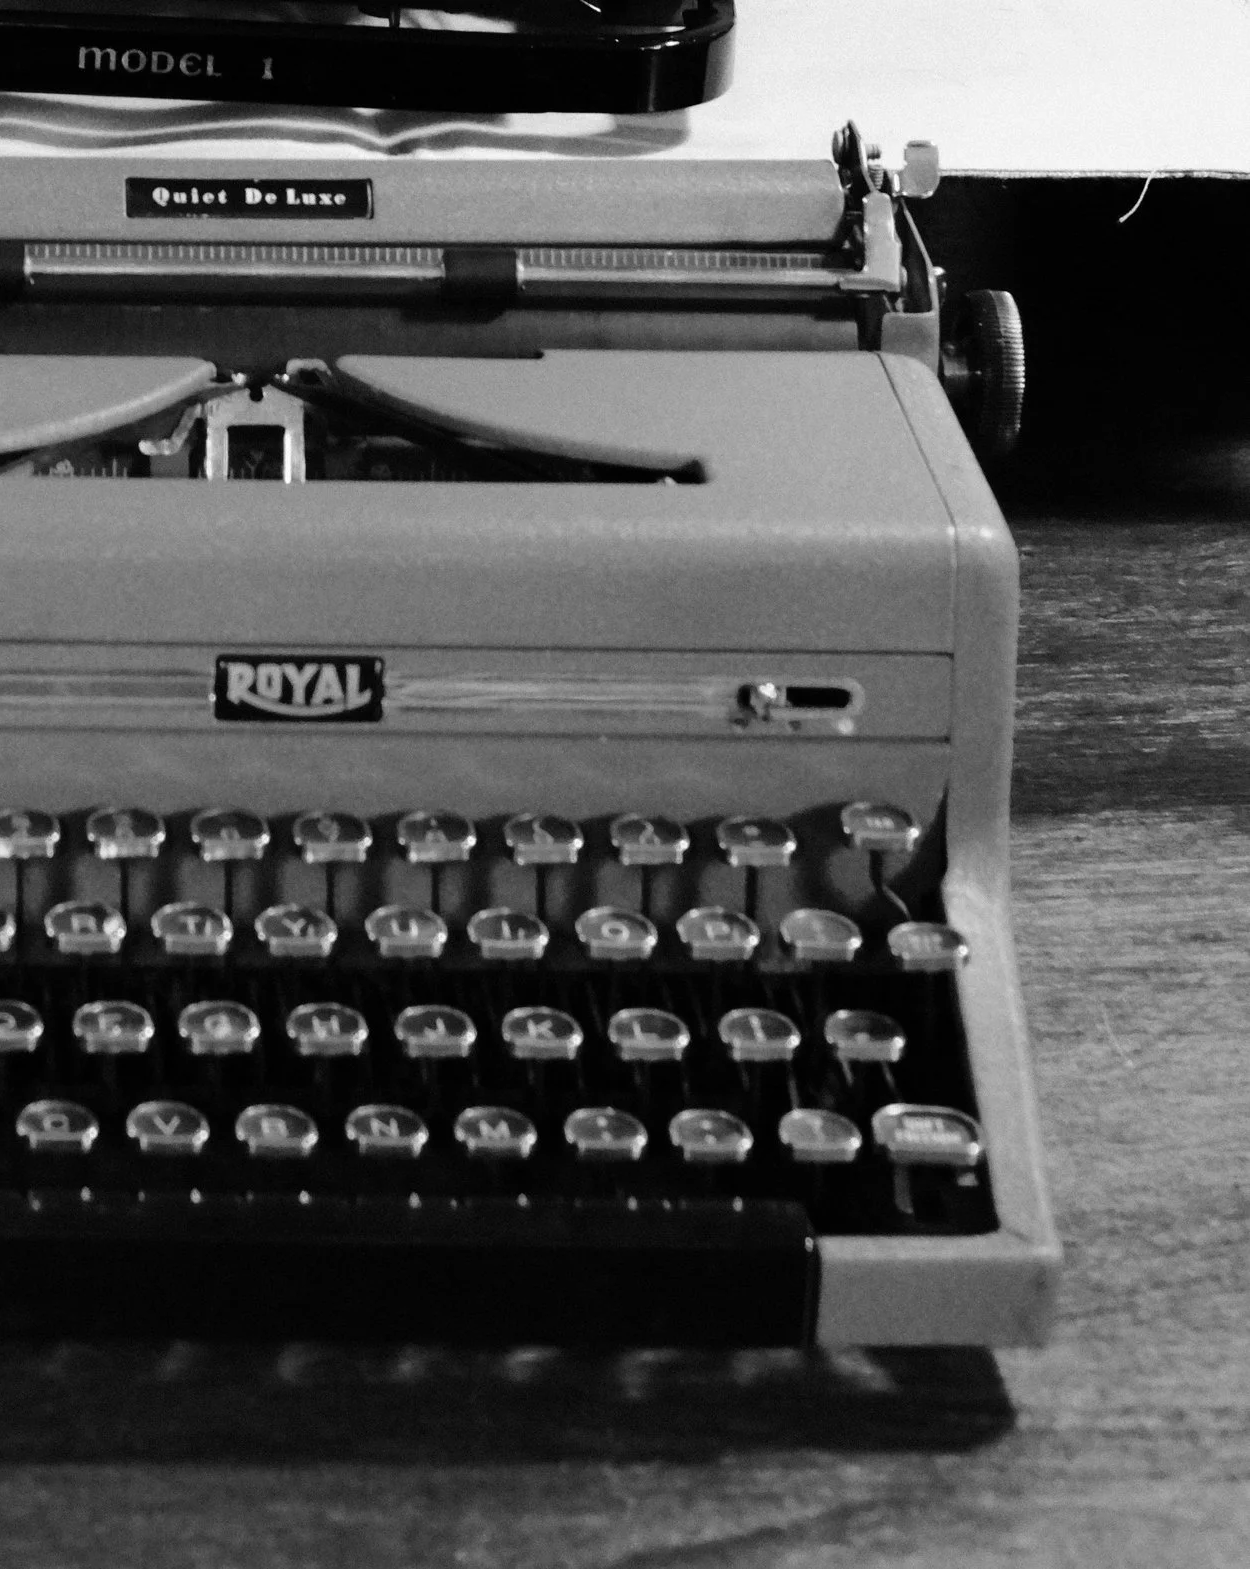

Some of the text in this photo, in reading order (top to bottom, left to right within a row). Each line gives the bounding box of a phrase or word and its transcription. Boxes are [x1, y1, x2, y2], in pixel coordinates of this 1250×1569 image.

[78, 46, 223, 77] MODEL
[152, 186, 228, 208] Quiet
[226, 662, 373, 717] ROYAL
[389, 918, 419, 939] U
[311, 1014, 341, 1038] H
[526, 1018, 554, 1040] K
[153, 1115, 180, 1136] V
[369, 1117, 399, 1138] N
[479, 1118, 511, 1140] M
